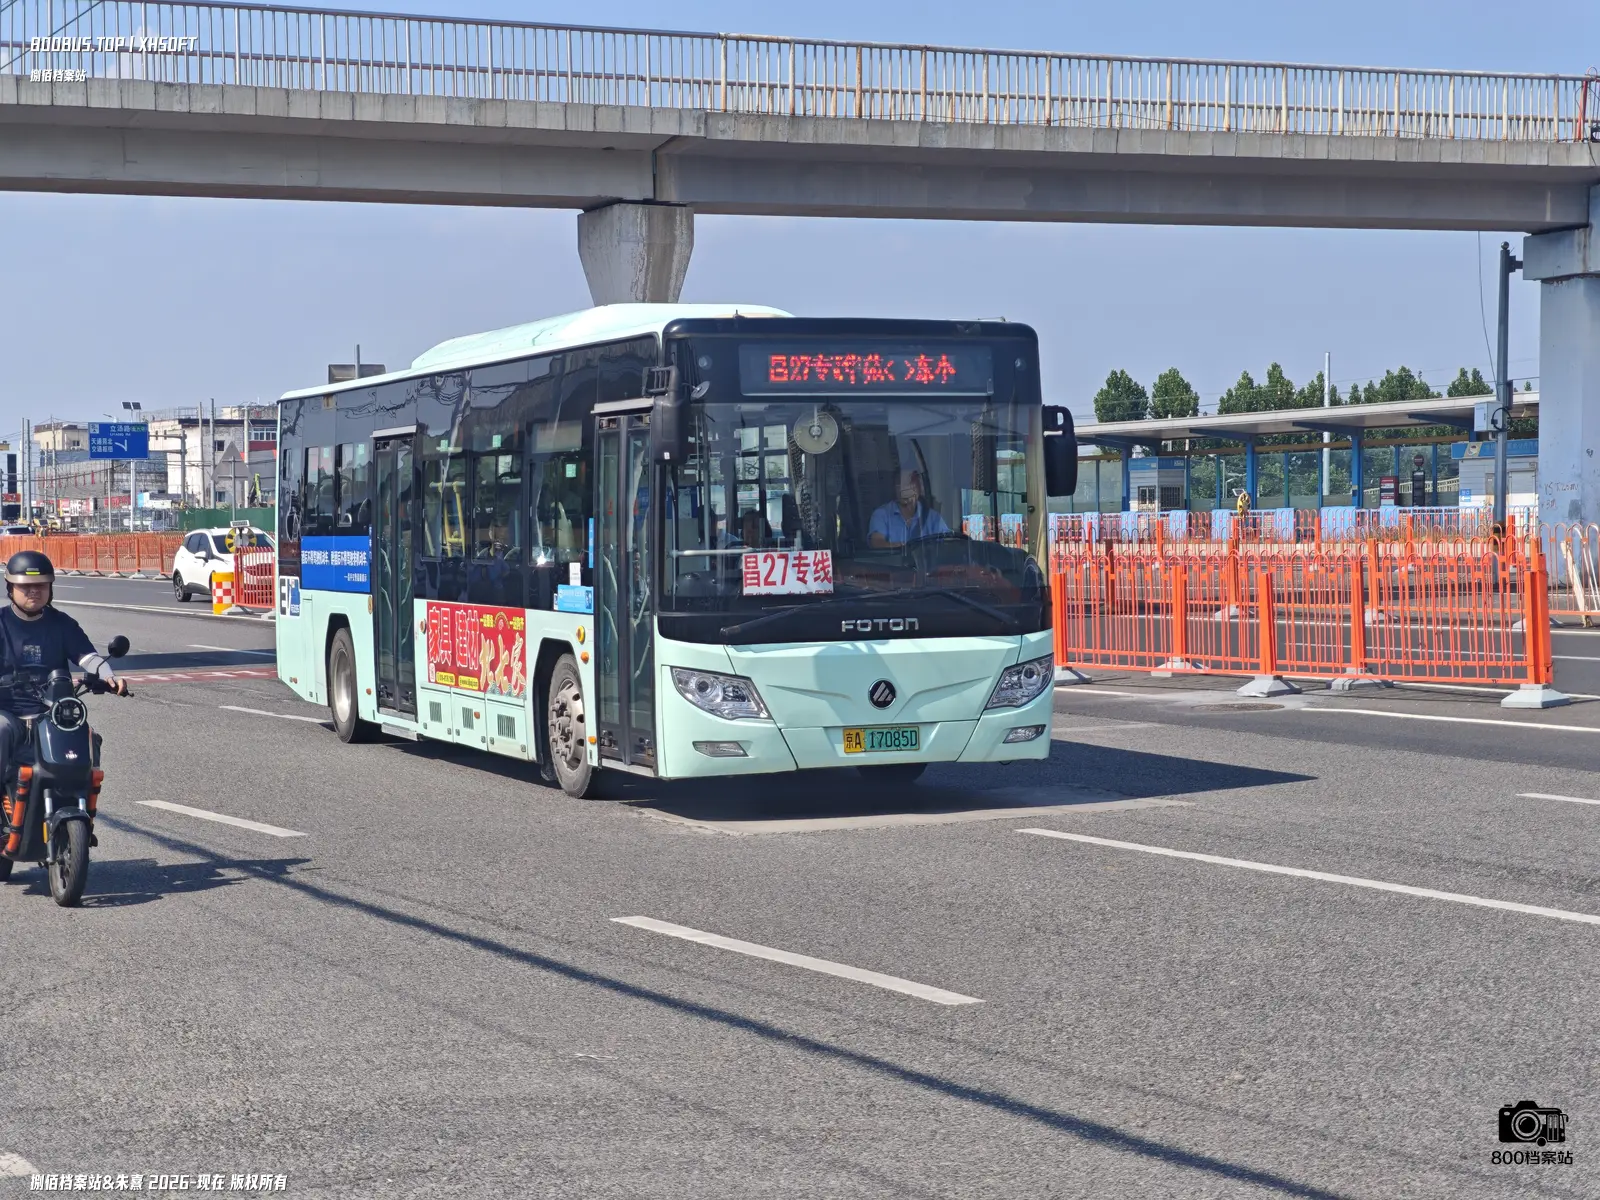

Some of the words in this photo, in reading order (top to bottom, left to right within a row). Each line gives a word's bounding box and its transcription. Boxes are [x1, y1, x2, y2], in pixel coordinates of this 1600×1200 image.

[744, 551, 832, 587] 昌27专线
[841, 618, 919, 632] FOTON
